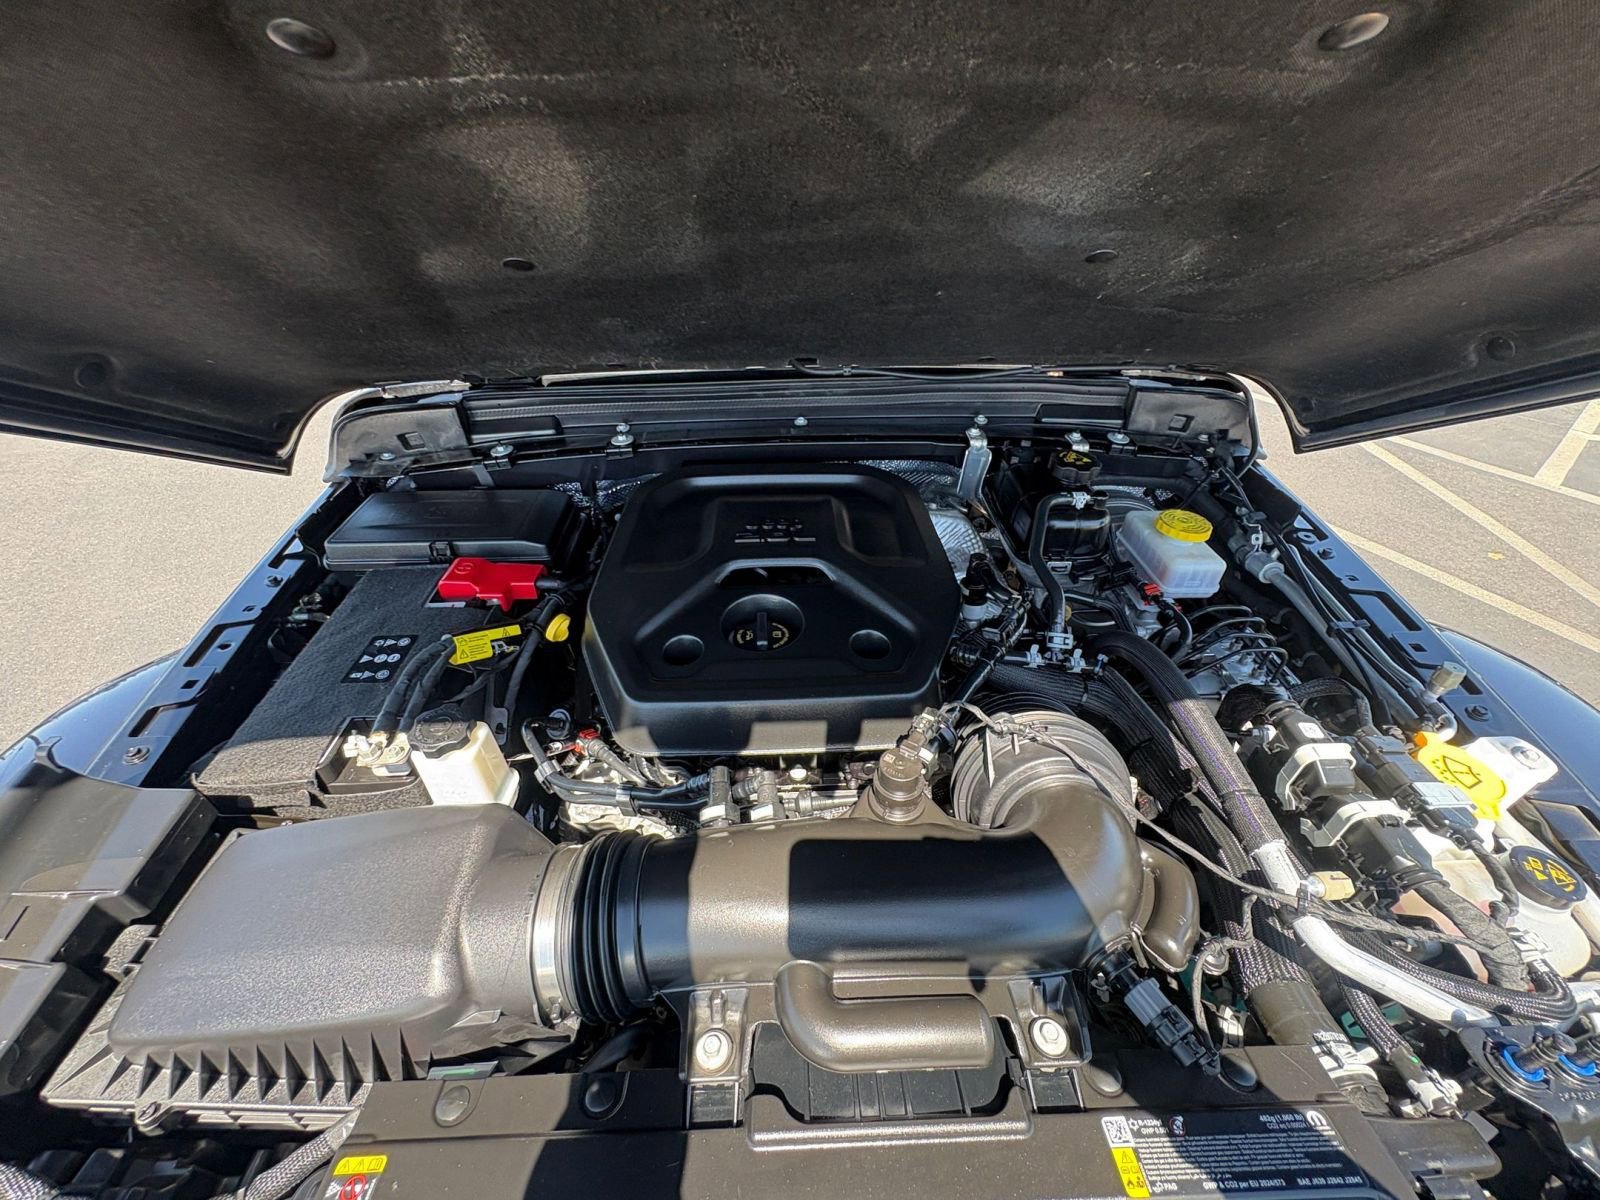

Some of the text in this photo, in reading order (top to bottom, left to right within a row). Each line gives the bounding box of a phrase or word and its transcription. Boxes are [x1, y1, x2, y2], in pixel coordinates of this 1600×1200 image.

[1163, 1182, 1178, 1191] PAG
[1202, 1181, 1218, 1190] GWP
[1224, 1181, 1238, 1189] CO2
[1250, 1180, 1259, 1188] EU
